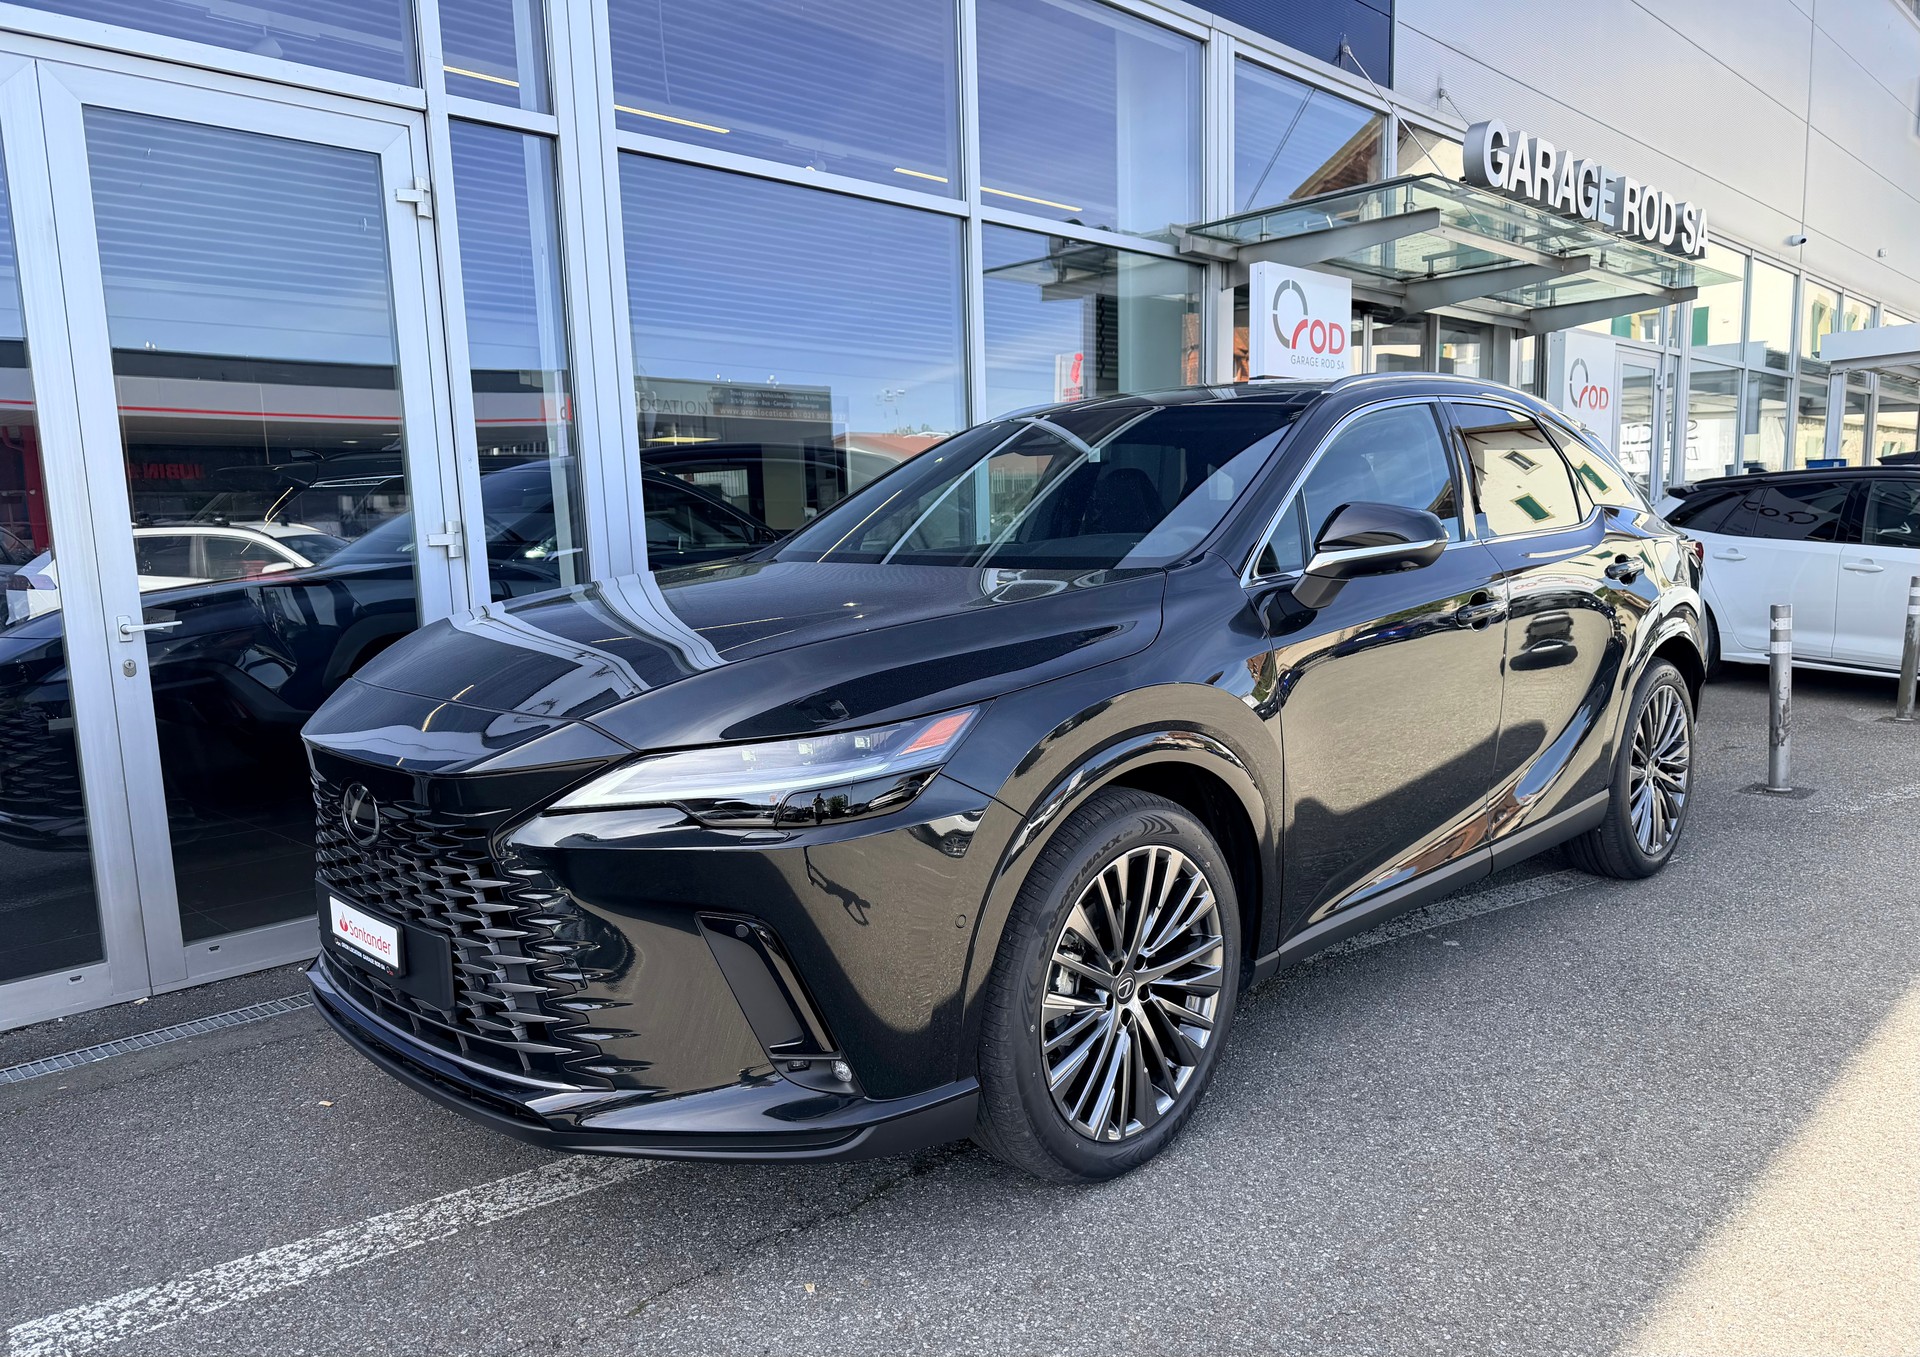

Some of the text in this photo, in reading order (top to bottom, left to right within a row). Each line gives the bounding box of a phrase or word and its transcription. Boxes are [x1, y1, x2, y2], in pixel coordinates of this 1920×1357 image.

[1481, 118, 1708, 259] GARAGE ROD SA
[1290, 354, 1345, 370] GARAGE ROD SA
[636, 397, 708, 415] OCATION
[720, 407, 798, 418] www.oronlocation.ch
[1081, 834, 1122, 877] MAXX
[348, 919, 392, 956] Santander
